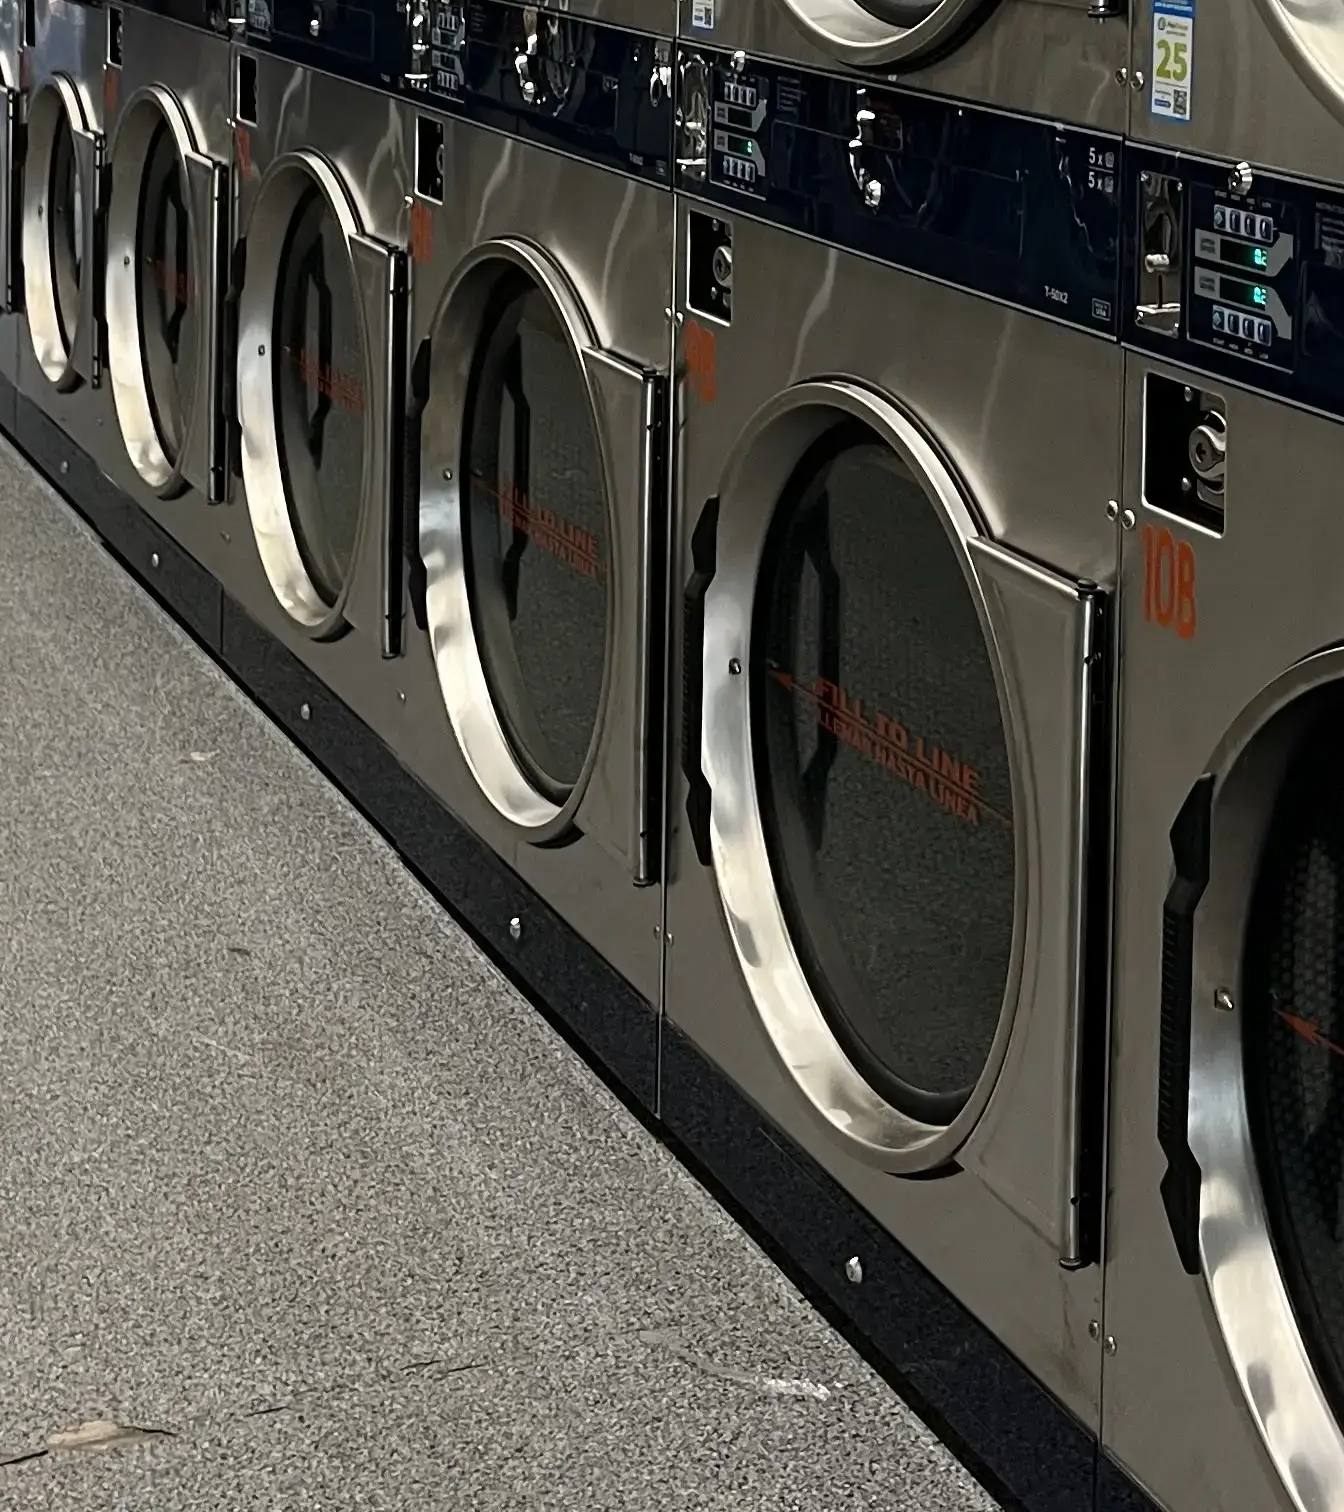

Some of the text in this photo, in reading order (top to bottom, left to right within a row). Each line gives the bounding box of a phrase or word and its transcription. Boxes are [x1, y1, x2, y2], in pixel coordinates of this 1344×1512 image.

[1156, 39, 1187, 81] 25
[1088, 147, 1096, 164] 5
[1088, 172, 1095, 189] 5
[1141, 524, 1196, 640] 10B
[875, 710, 908, 752] TO
[915, 736, 983, 799] LINE
